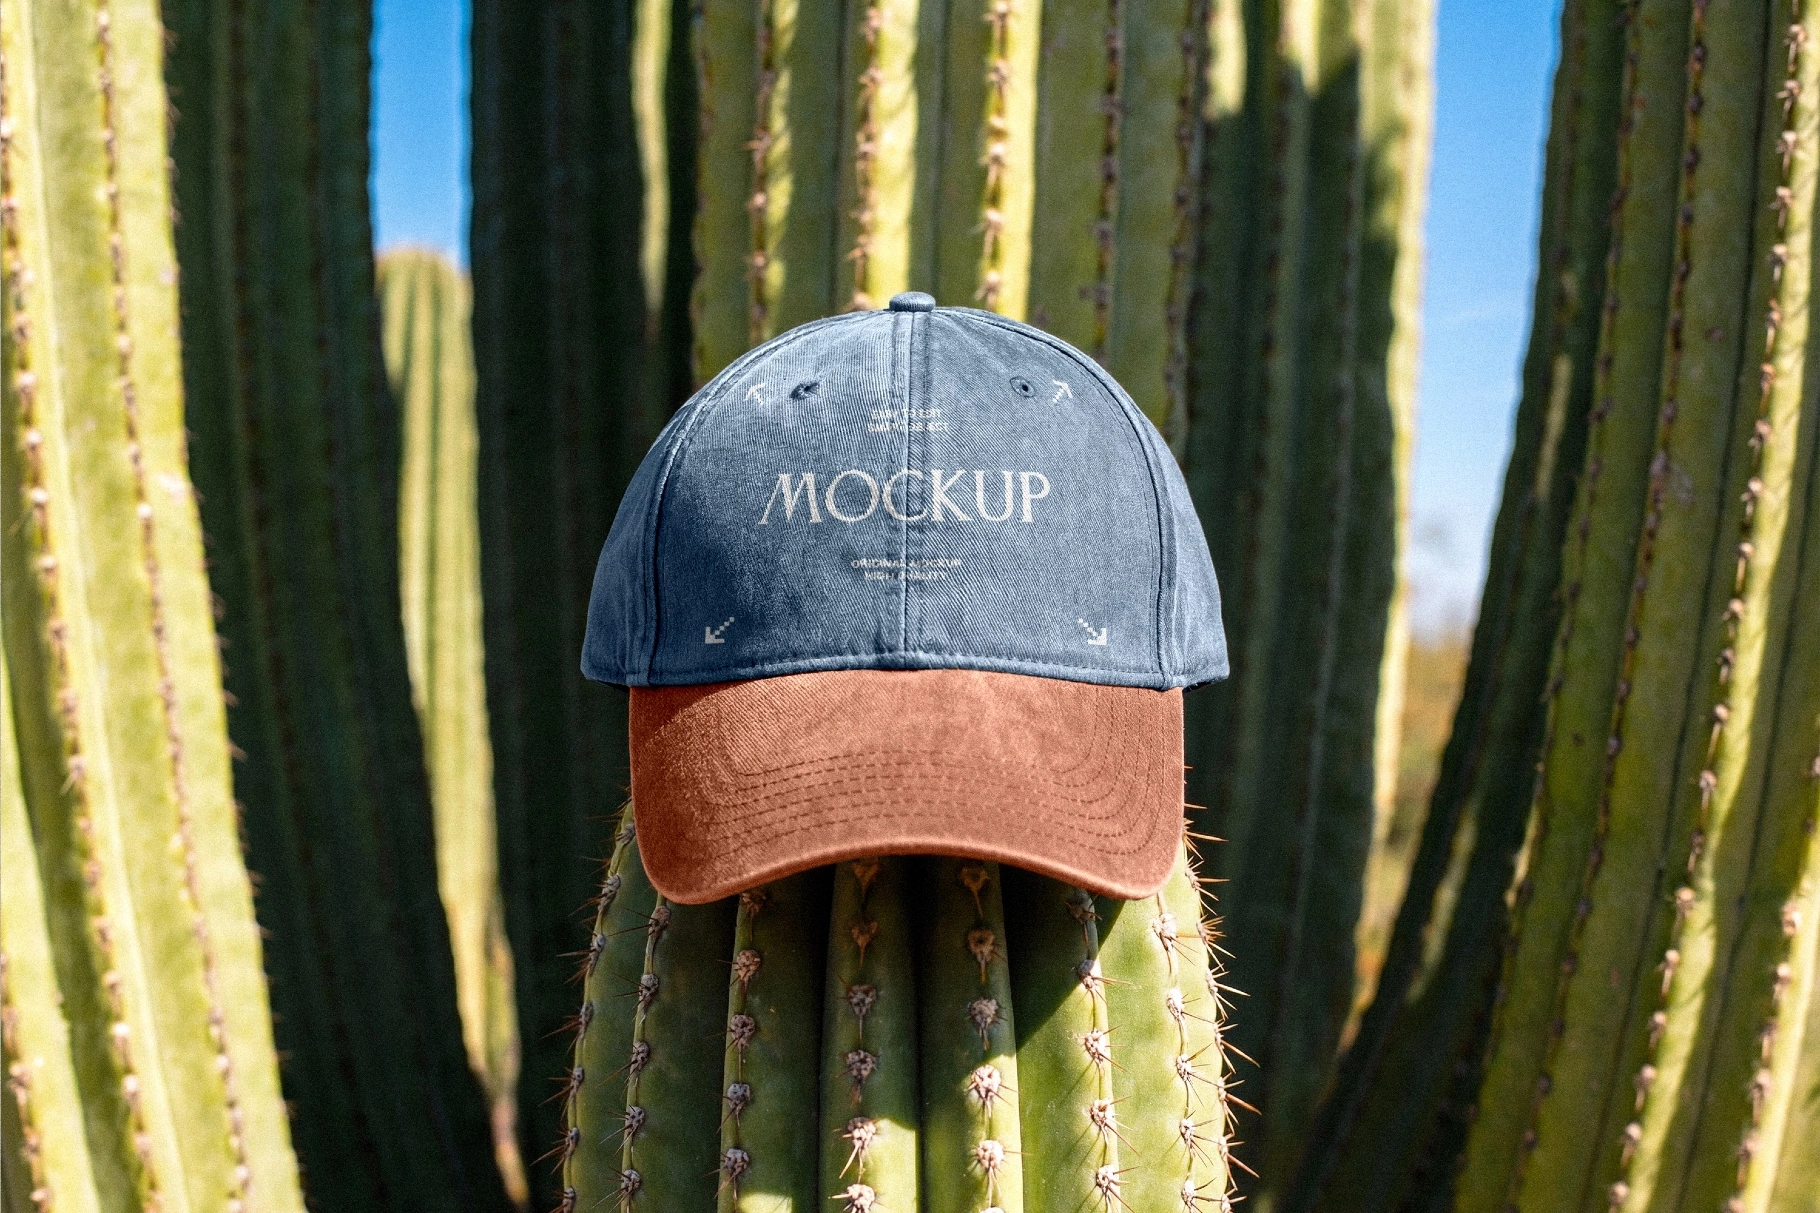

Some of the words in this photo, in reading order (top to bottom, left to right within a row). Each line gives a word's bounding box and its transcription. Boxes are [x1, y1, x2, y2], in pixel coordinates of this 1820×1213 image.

[758, 468, 1052, 525] MOCKUP
[850, 558, 907, 569] ORIGINAL
[864, 570, 895, 581] HIGH
